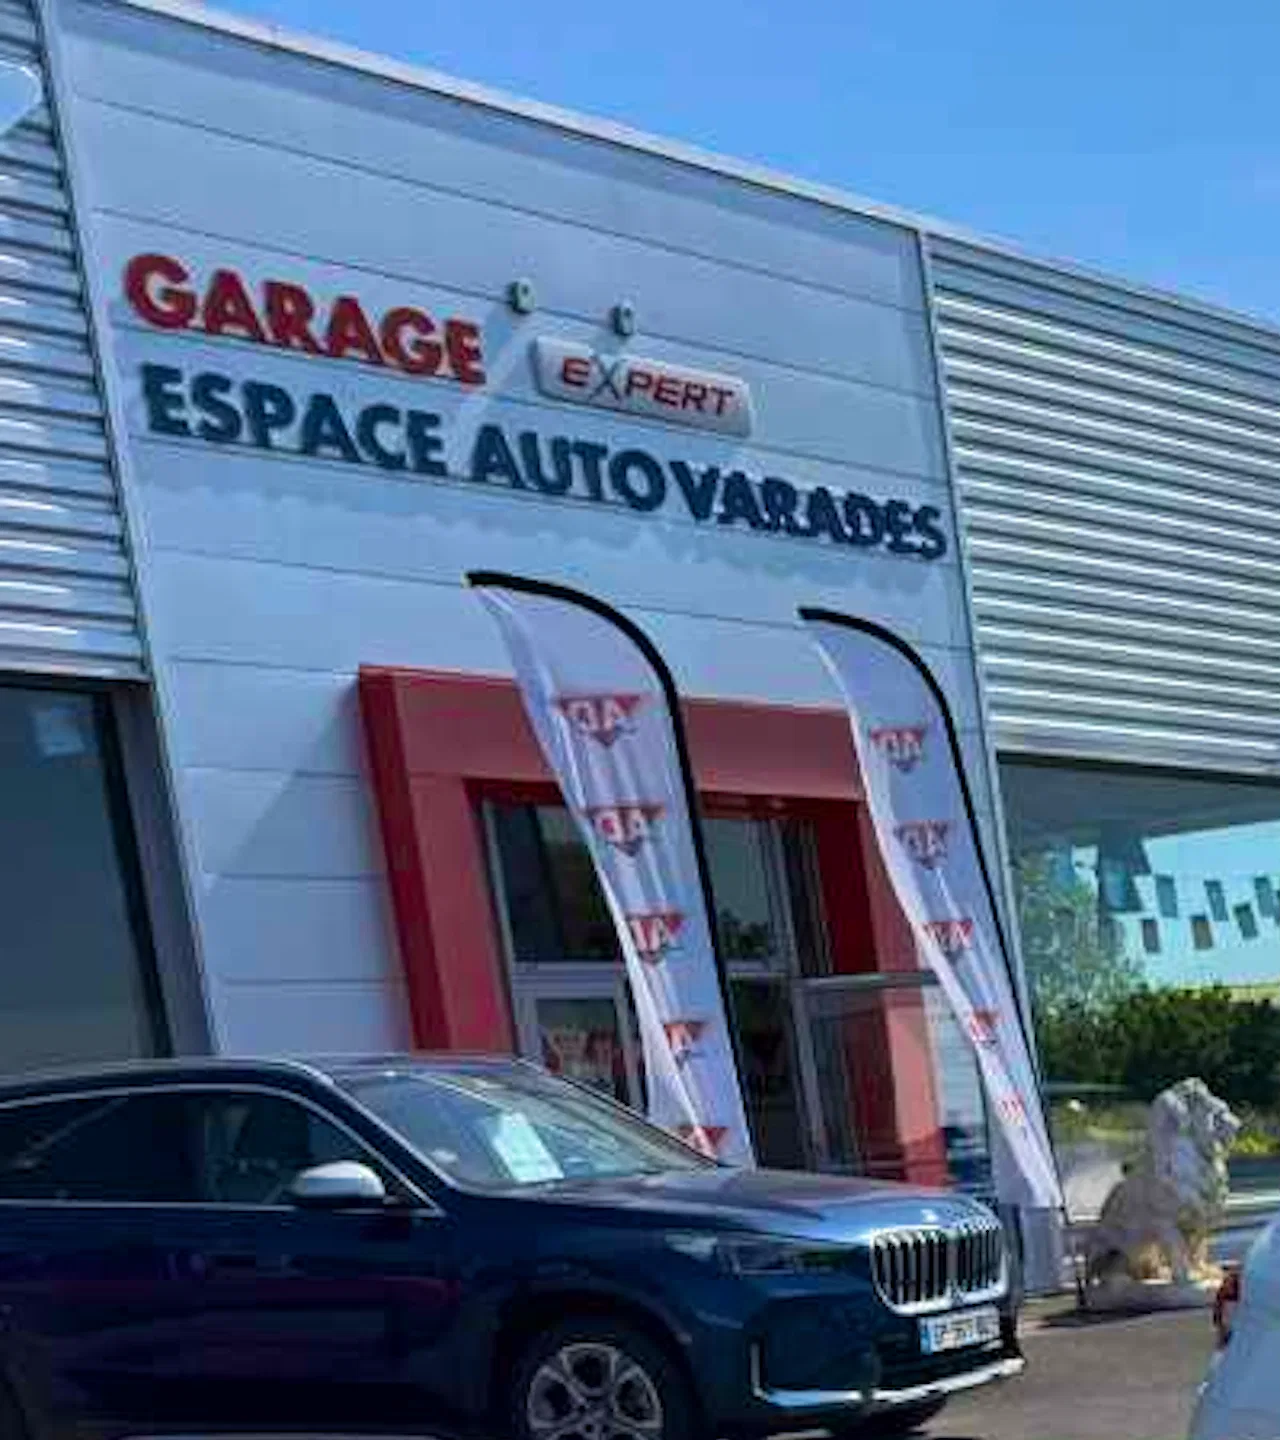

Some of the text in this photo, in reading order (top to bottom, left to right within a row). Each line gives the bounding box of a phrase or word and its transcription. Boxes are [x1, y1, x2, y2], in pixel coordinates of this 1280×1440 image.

[123, 252, 487, 386] GARAGE
[559, 355, 738, 417] EXPERT
[140, 362, 948, 561] ESPACE AUTO VARADES
